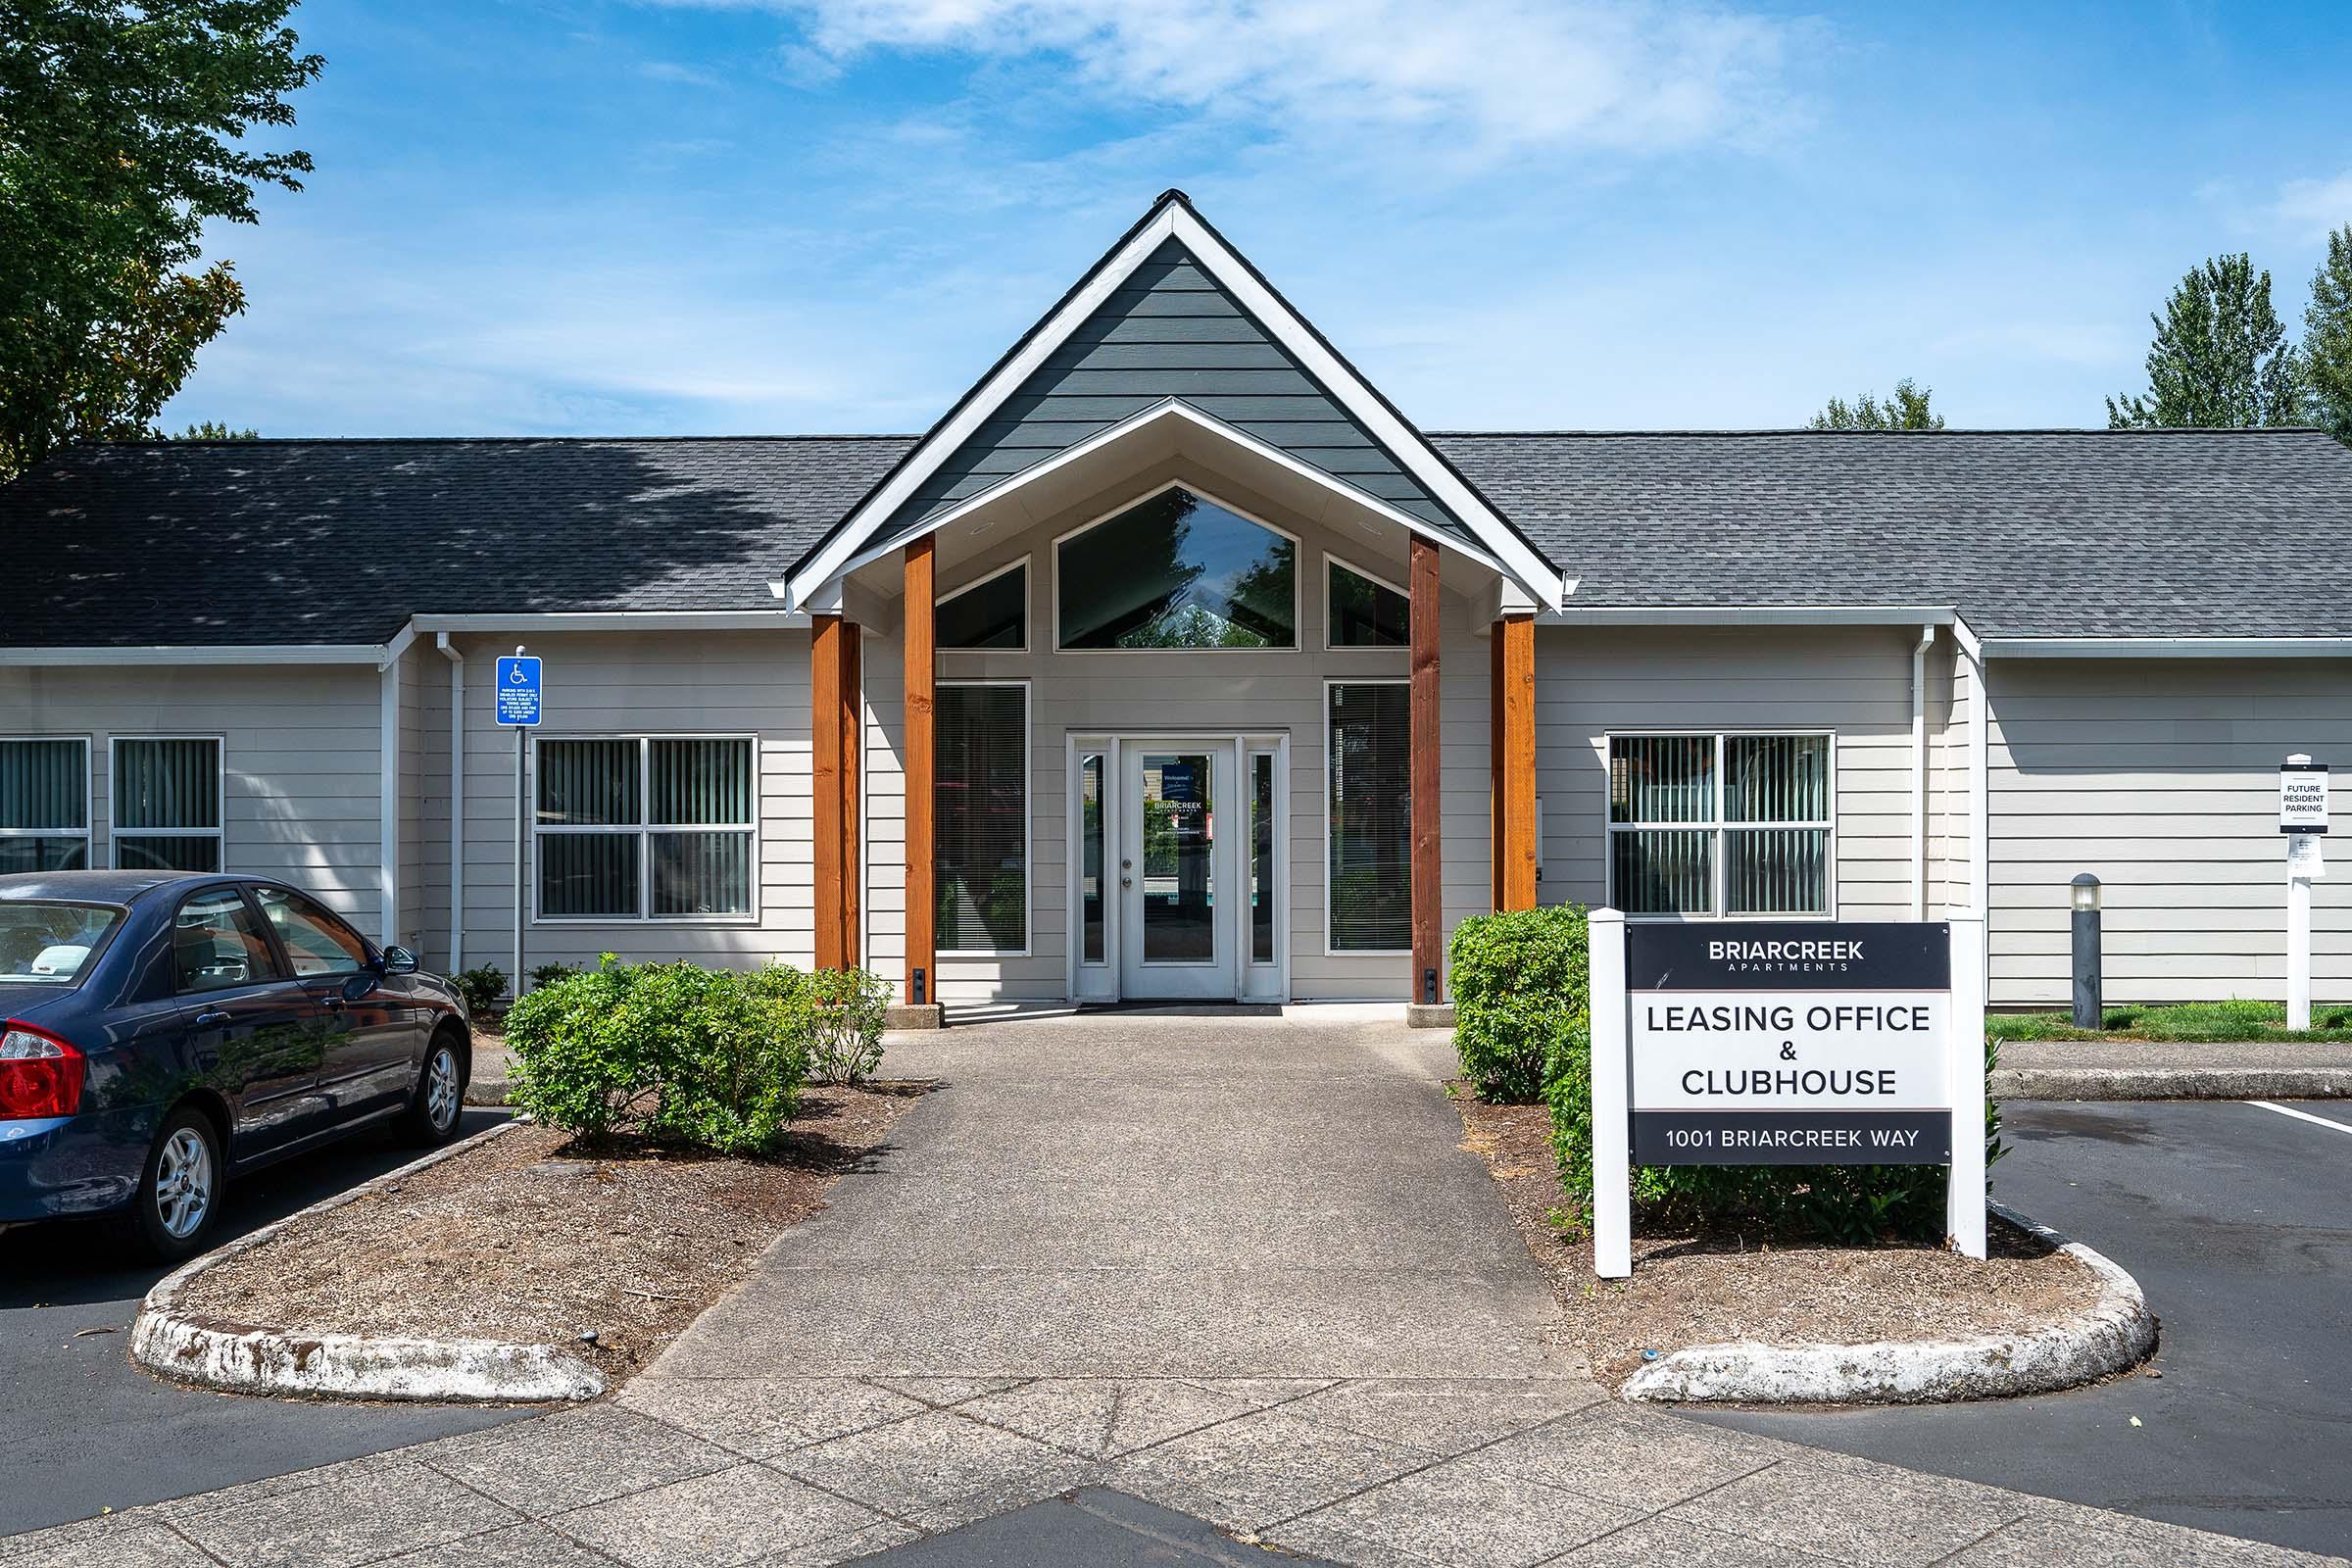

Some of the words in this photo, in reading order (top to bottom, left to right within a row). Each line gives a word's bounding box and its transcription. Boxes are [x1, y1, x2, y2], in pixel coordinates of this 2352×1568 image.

[1709, 942, 1864, 960] BRIARCREEK
[1729, 963, 1848, 972] APARTMENTS
[1648, 1006, 1793, 1032] LEASING
[1807, 1006, 1930, 1032] OFFICE
[1780, 1041, 1797, 1061] &
[1682, 1070, 1896, 1096] CLUBHOUSE
[1667, 1130, 1712, 1148] 1001
[1722, 1130, 1862, 1148] BRIARCREEK
[1871, 1130, 1920, 1148] WAY
